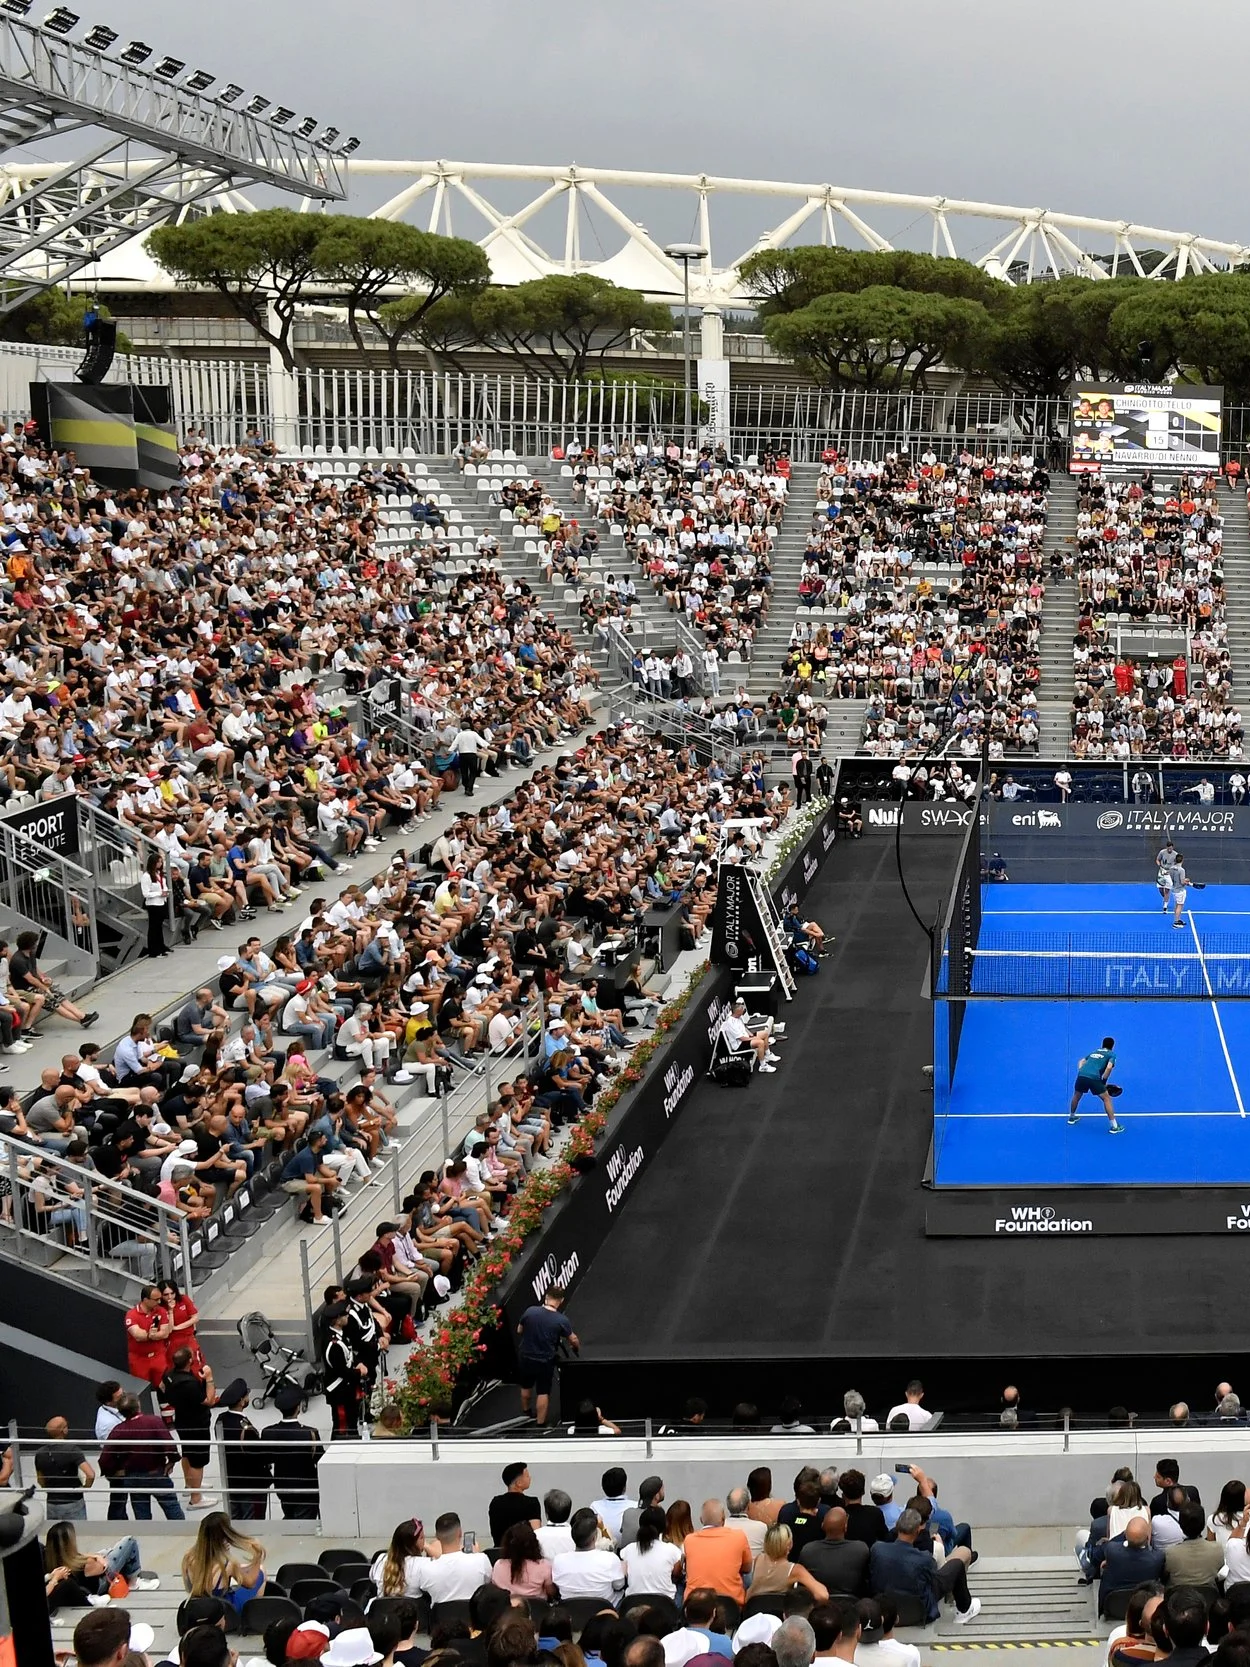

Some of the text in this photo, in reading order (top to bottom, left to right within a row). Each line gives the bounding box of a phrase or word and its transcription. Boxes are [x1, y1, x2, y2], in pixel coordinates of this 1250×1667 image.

[1153, 436, 1164, 444] 15
[1012, 810, 1036, 826] eni
[1127, 810, 1235, 825] ITALY MAJOR
[725, 875, 736, 940] ITALY MAJOR
[1105, 964, 1190, 988] ITALY
[663, 1064, 694, 1119] Foundation
[605, 1145, 644, 1213] Foundation
[995, 1218, 1092, 1232] Foundation
